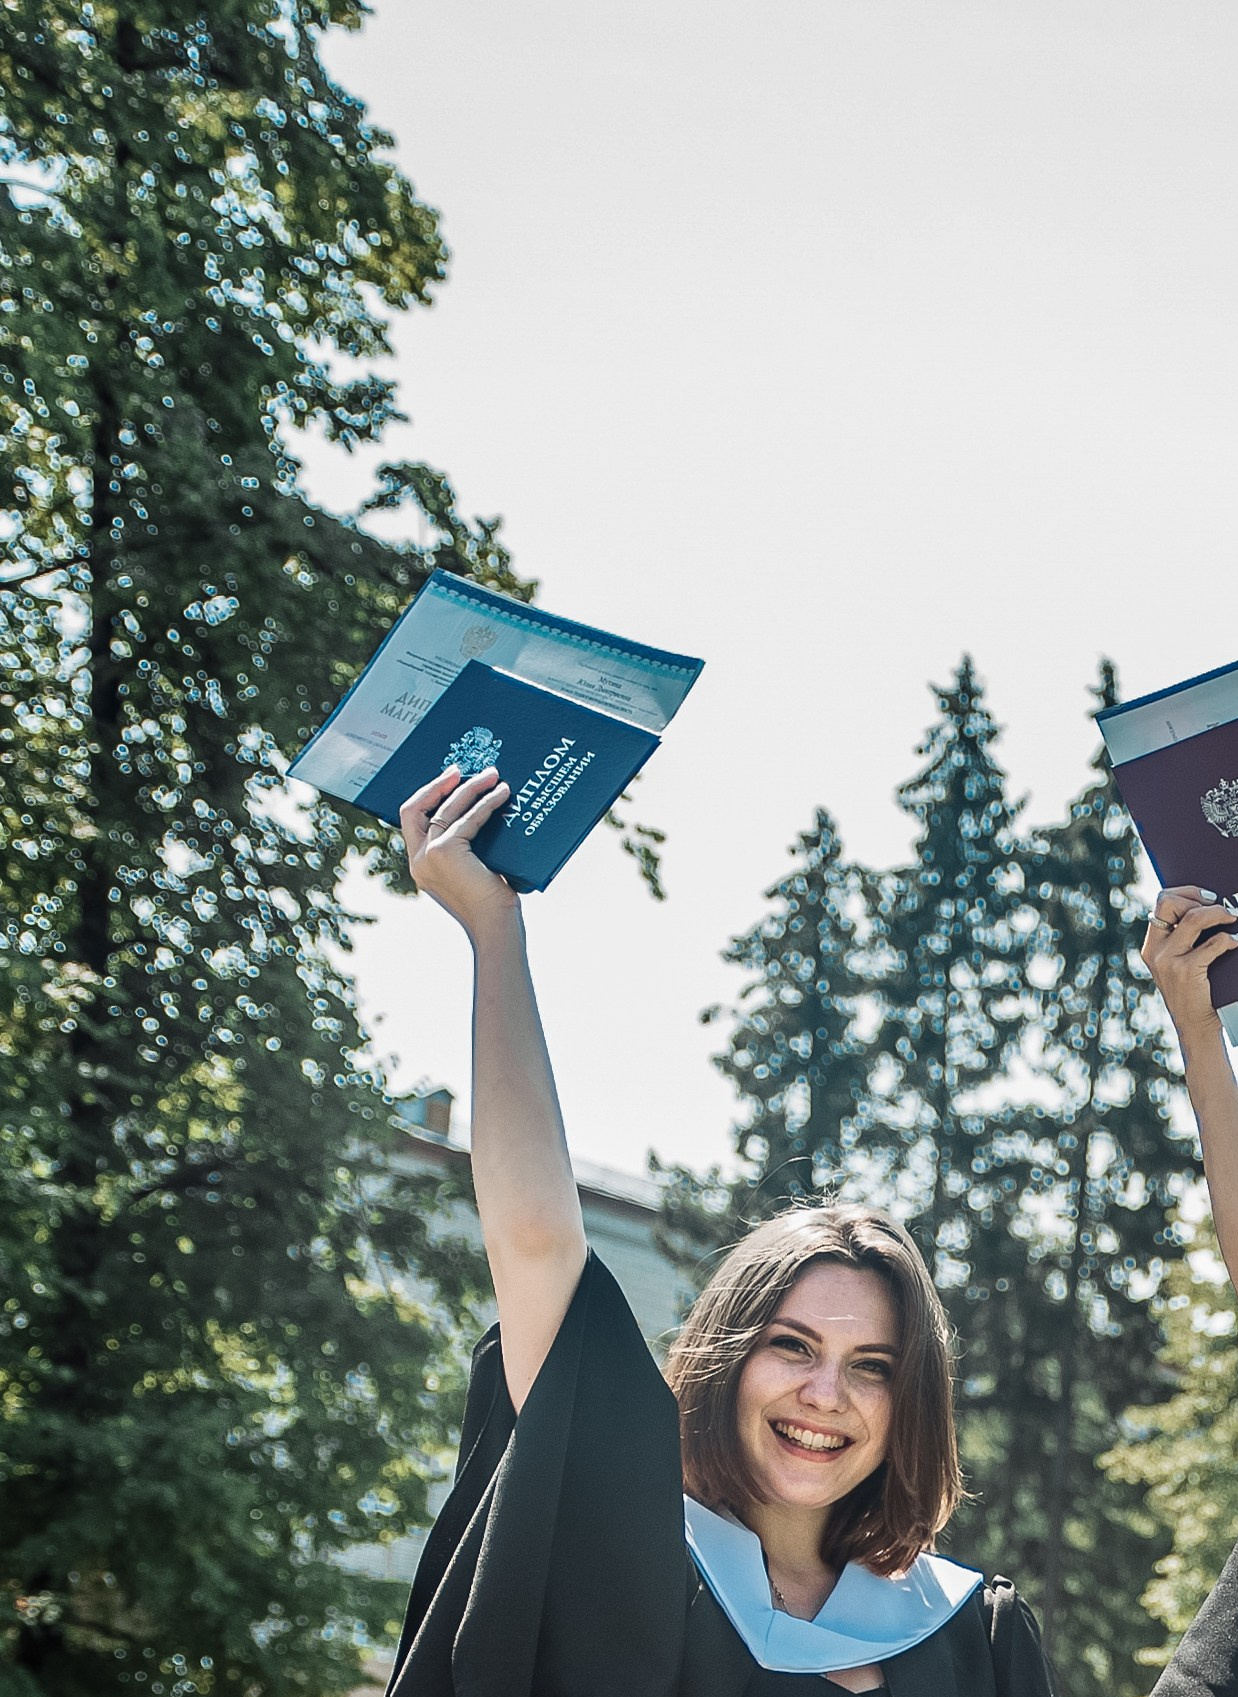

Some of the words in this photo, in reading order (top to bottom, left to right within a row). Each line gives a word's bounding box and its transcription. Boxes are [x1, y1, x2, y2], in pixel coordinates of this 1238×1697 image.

[380, 703, 423, 725] МАГИ
[395, 692, 432, 711] ДИП
[502, 737, 576, 828] ДИПЛОМ
[521, 811, 533, 822] О
[531, 756, 578, 810] ВЫСШЕМ
[524, 751, 596, 836] ОБРАЗОВАНИИ
